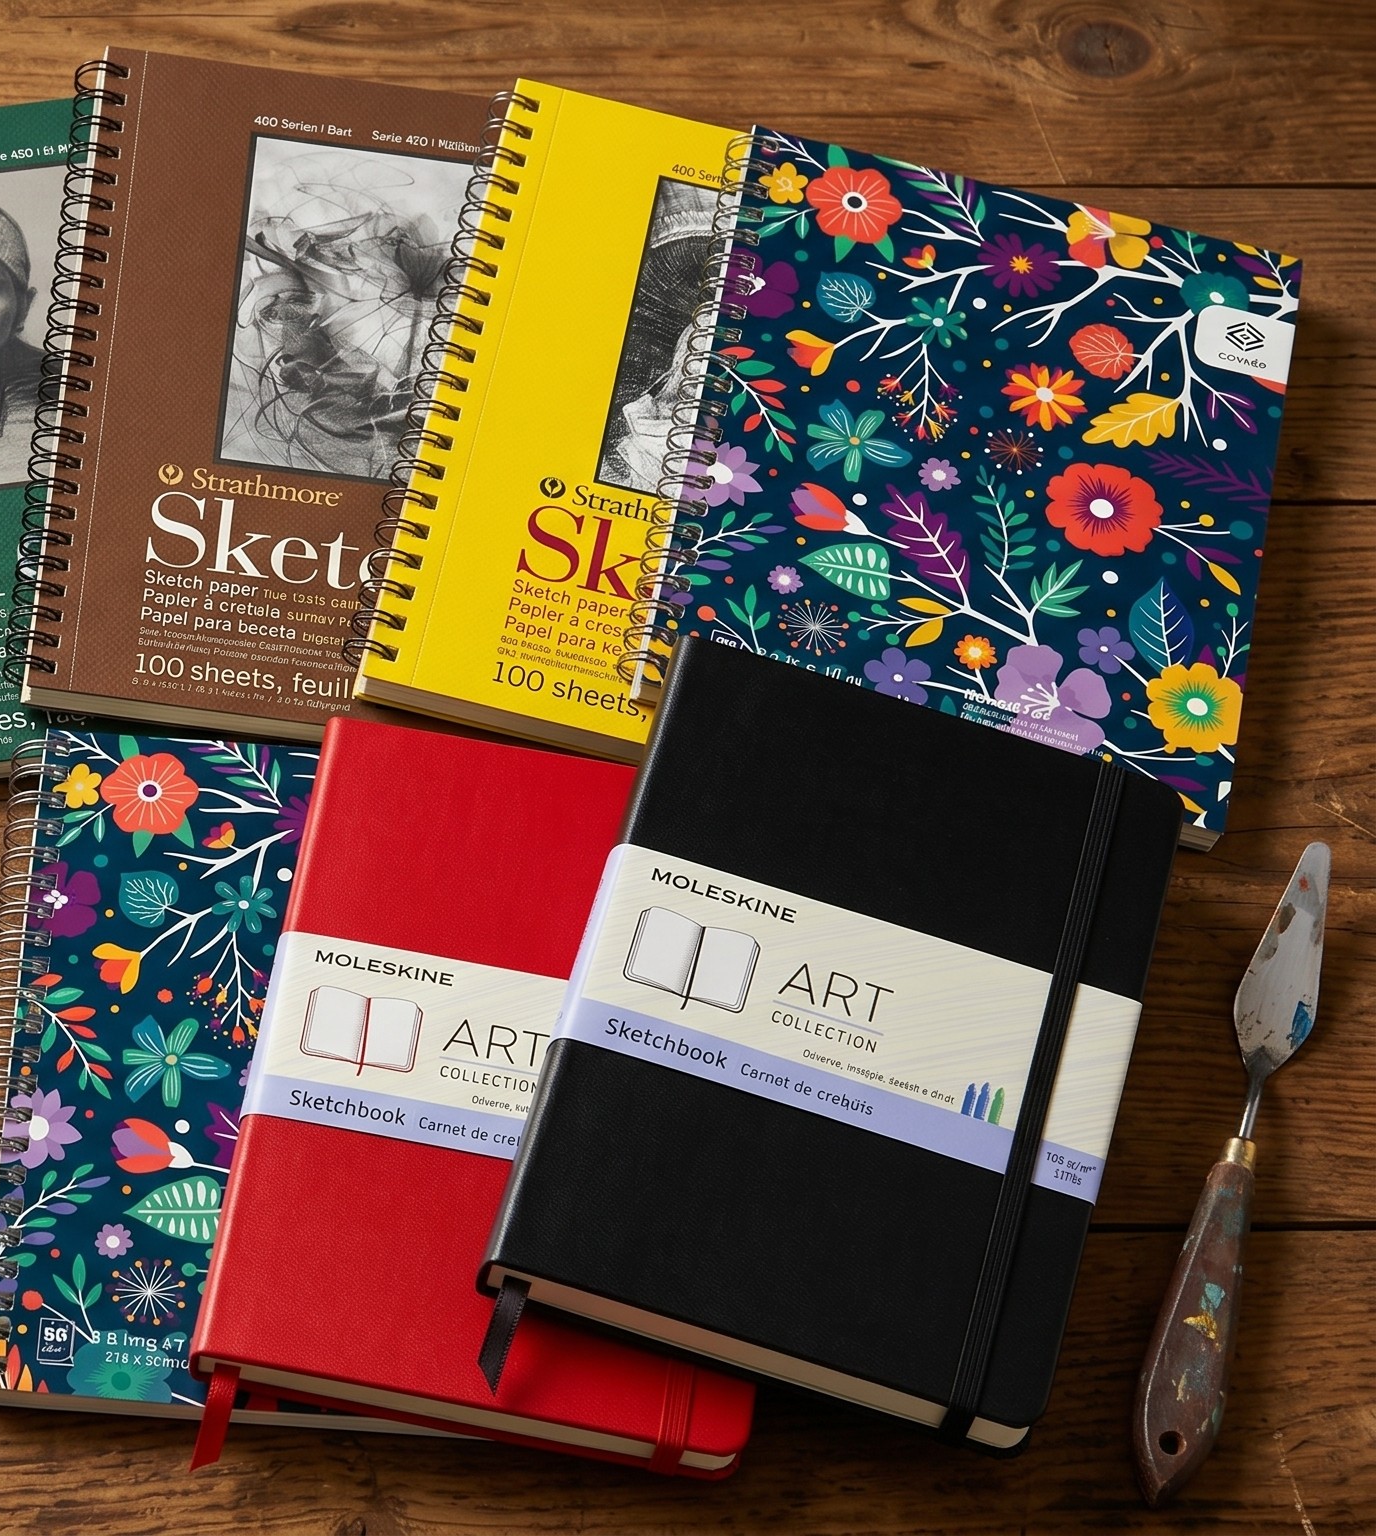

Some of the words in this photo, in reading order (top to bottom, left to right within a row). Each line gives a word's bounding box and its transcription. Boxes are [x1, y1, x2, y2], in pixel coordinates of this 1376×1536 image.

[327, 125, 353, 137] Bart
[672, 164, 696, 178] 400
[572, 485, 653, 523] Strath
[517, 505, 646, 601] Sk
[144, 569, 203, 591] Sketch
[209, 580, 259, 598] paper
[512, 578, 571, 606] Sketch
[141, 606, 189, 627] Papel
[194, 616, 232, 632] para
[238, 619, 296, 640] beceta
[504, 615, 553, 640] Papel
[557, 632, 596, 651] para
[602, 642, 623, 657] ke
[585, 619, 622, 638] cres
[135, 653, 184, 678] 100
[190, 661, 282, 695] sheets,
[293, 672, 355, 700] feuil
[492, 661, 545, 692] 100
[552, 678, 647, 723] sheets,
[651, 868, 797, 924] MOLESKINE
[314, 950, 455, 987] MOLESKINE
[778, 963, 895, 1023] ART
[442, 1019, 550, 1067] ART
[771, 1010, 878, 1054] COLLECTION
[604, 1018, 728, 1070] Sketchbook
[794, 1080, 813, 1096] de
[290, 1089, 406, 1126] Sketchbook
[419, 1116, 467, 1137] Carnet
[471, 1127, 489, 1141] de
